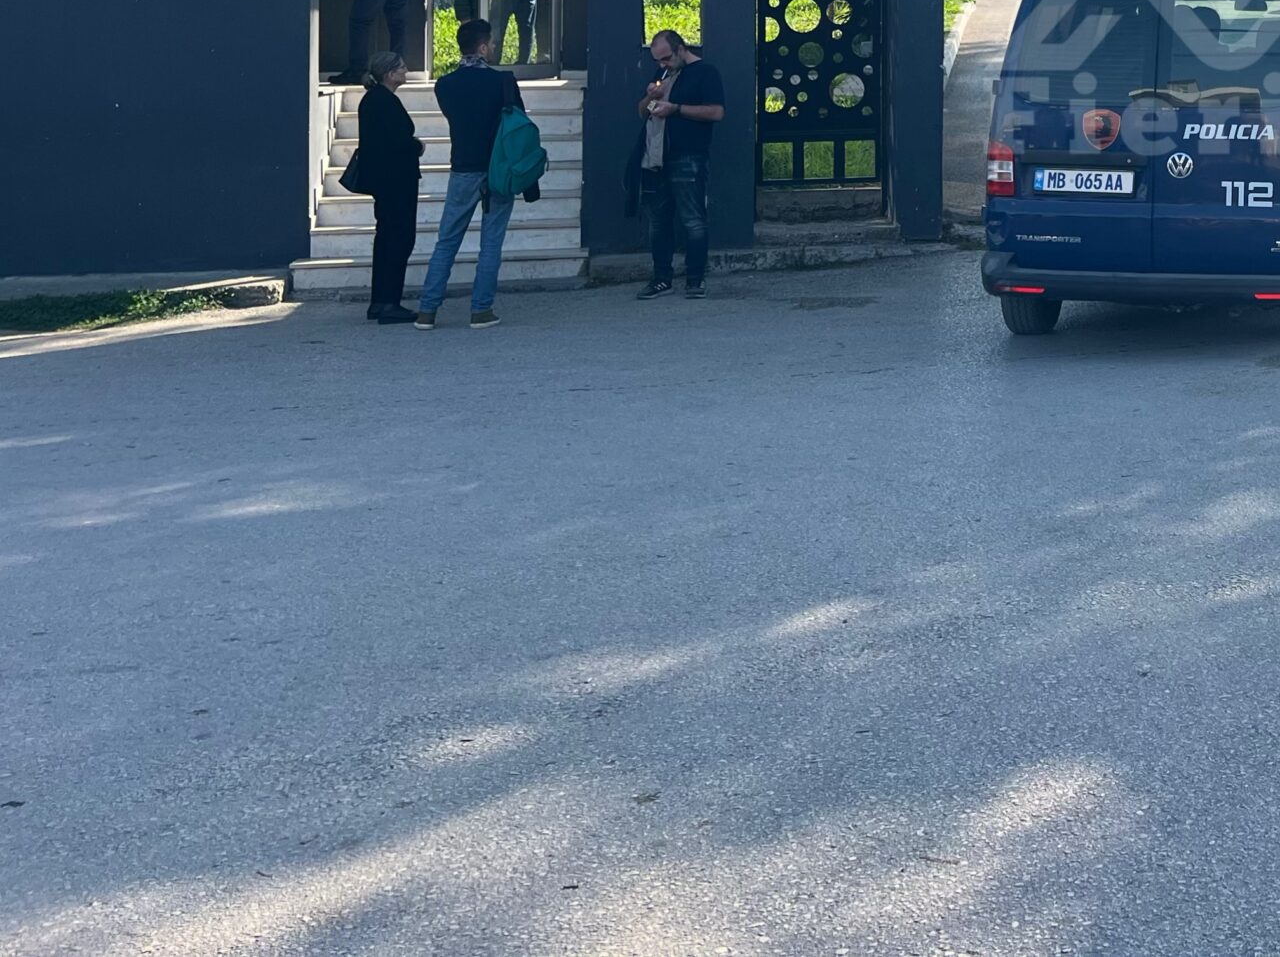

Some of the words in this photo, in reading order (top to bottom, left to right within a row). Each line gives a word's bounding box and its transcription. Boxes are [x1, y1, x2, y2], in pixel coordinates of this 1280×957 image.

[1183, 123, 1275, 140] POLICIA
[1047, 172, 1066, 189] MB
[1221, 181, 1274, 208] 112
[1016, 234, 1082, 244] TRANSPORTER
